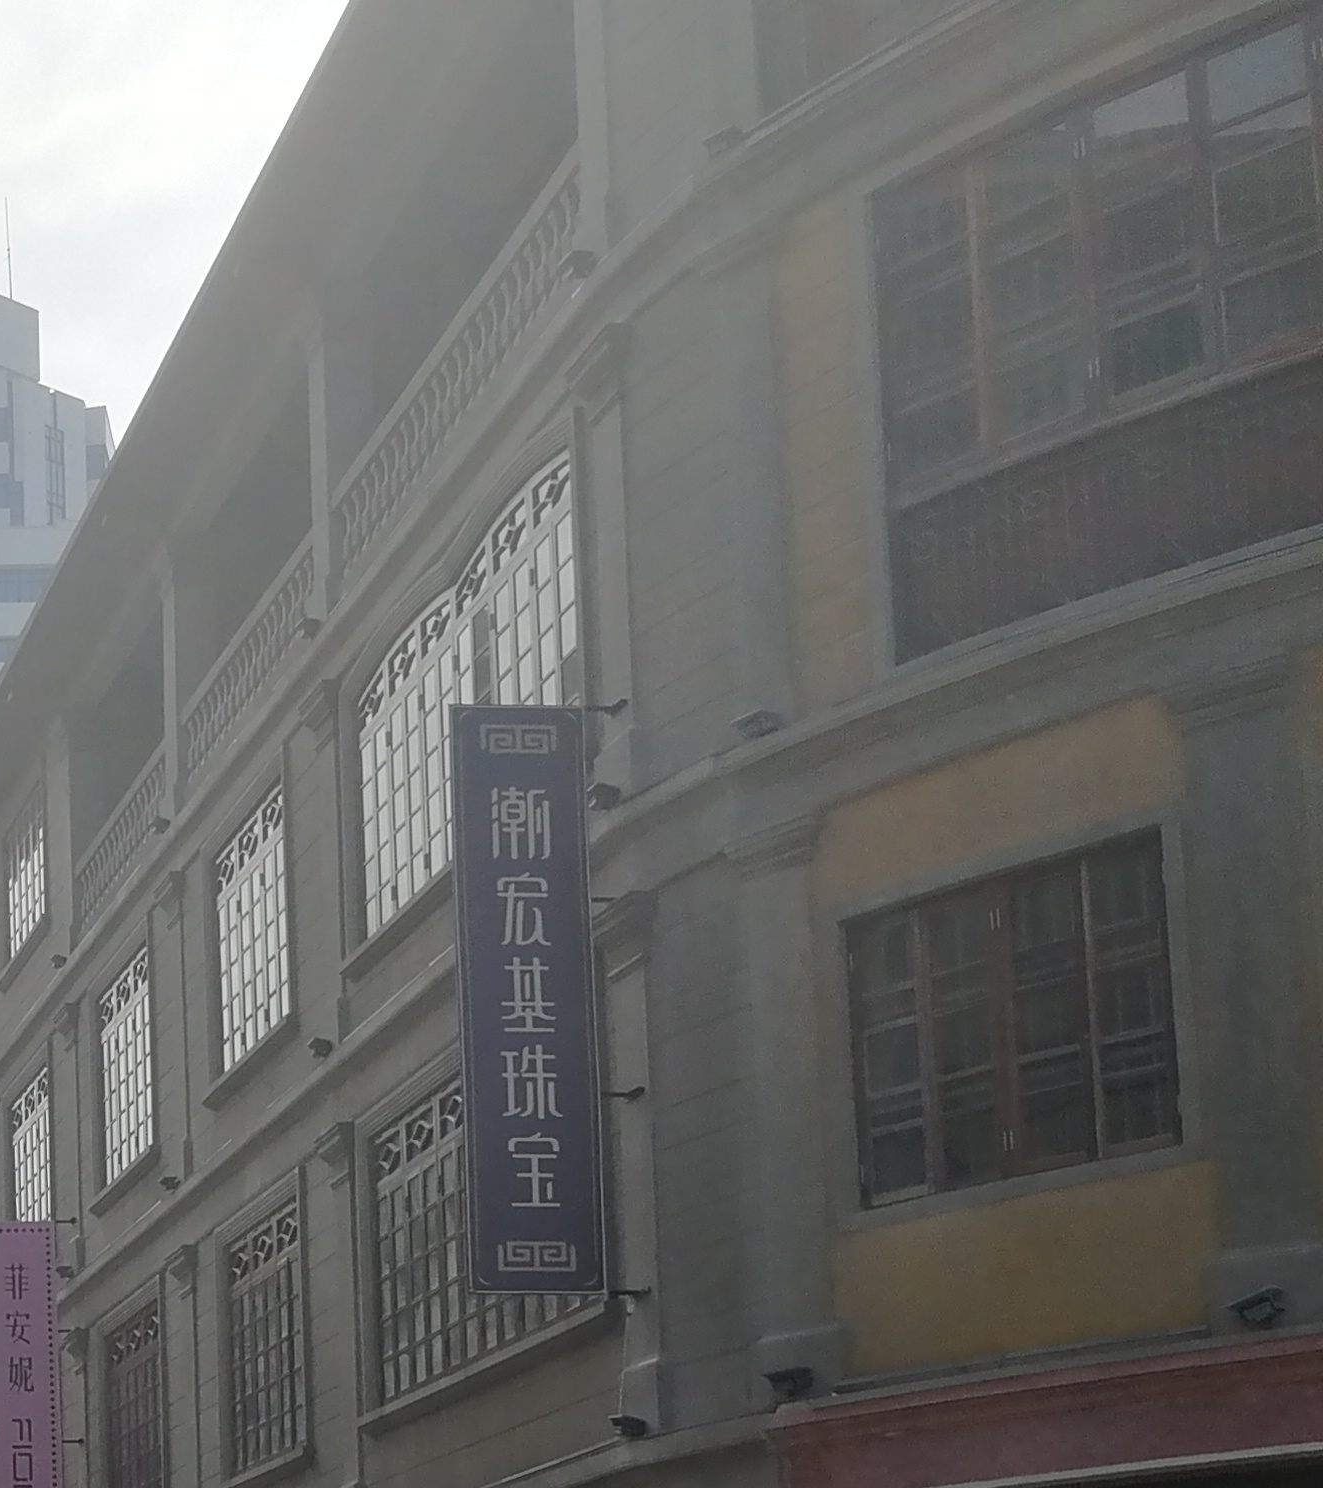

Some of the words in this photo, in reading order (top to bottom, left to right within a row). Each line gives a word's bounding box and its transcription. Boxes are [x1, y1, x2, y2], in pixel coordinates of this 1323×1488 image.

[491, 786, 563, 1208] 潮宏基珠宝
[4, 1263, 36, 1393] 菲安妮
